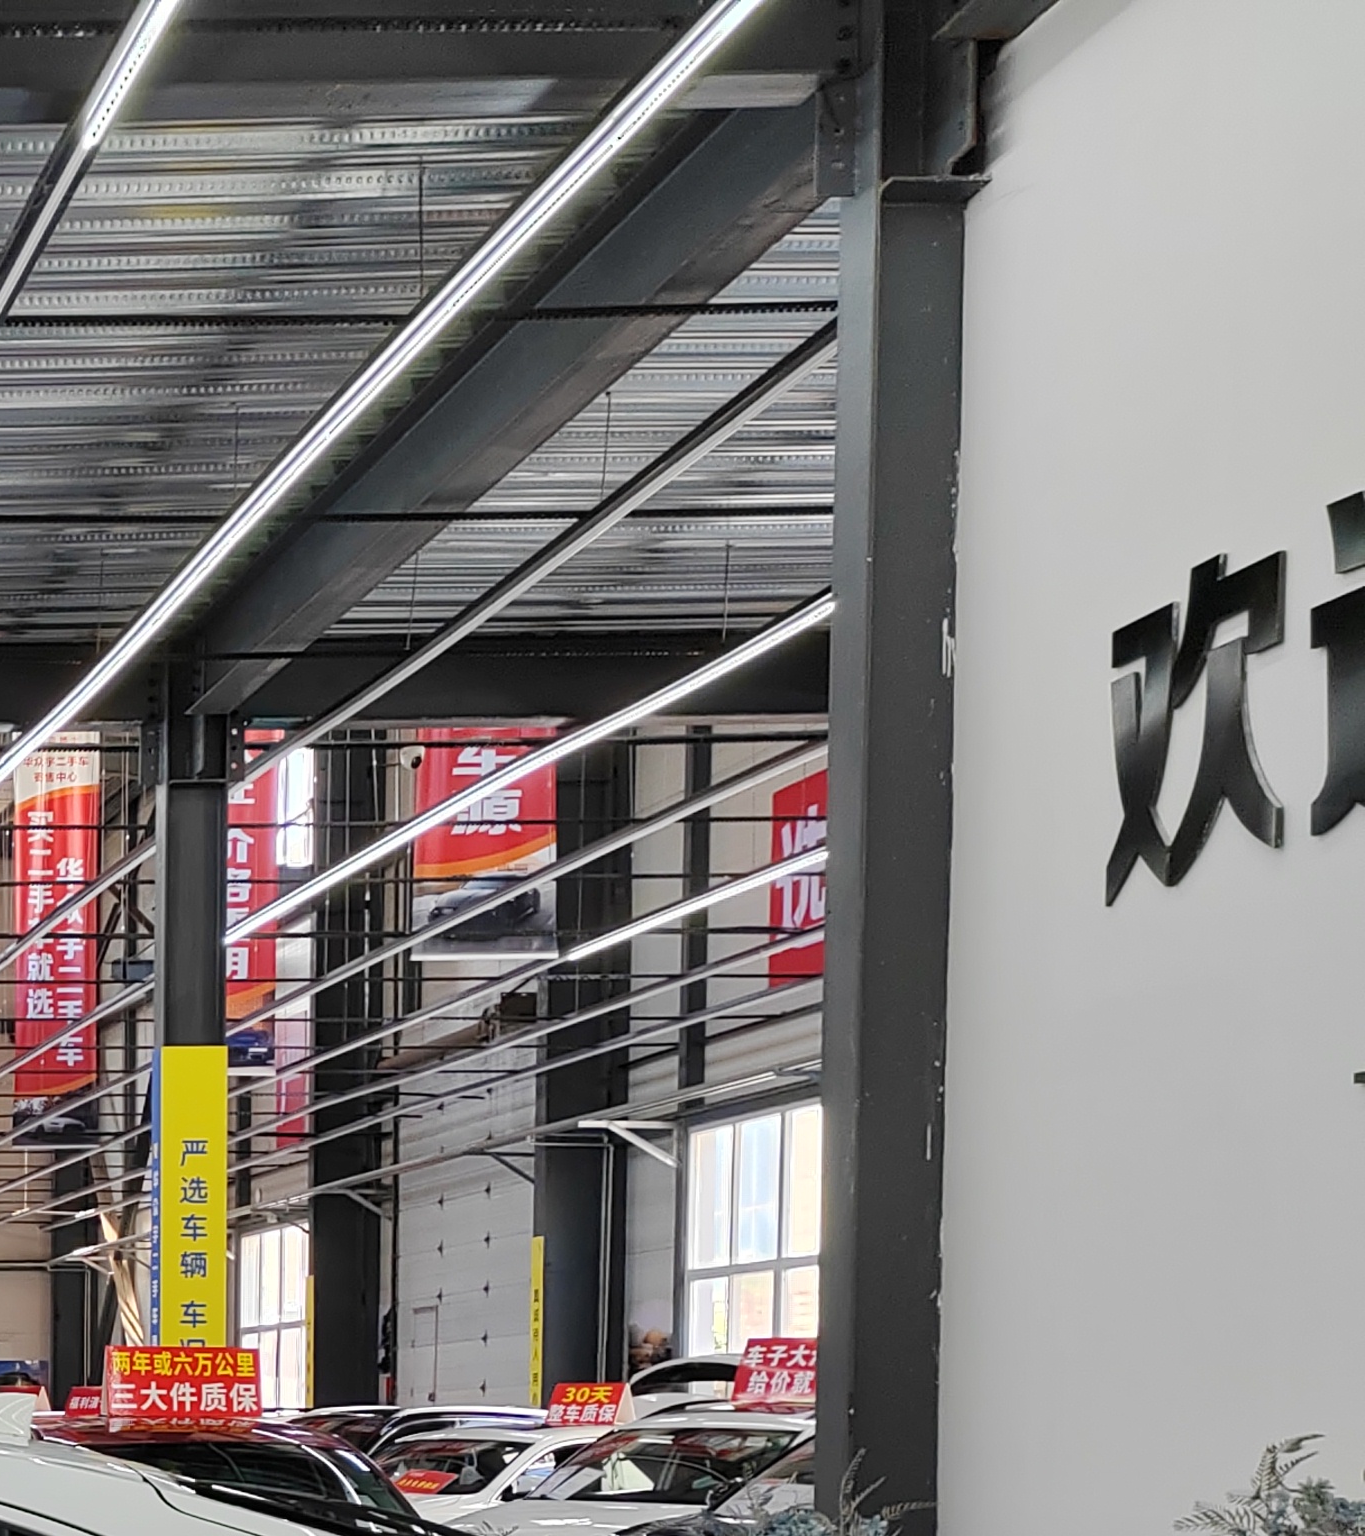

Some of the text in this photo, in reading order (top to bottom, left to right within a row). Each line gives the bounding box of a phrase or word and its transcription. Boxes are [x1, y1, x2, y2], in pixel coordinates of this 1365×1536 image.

[1104, 490, 1365, 907] 欢
[179, 1139, 209, 1279] 严选车辆
[111, 1351, 256, 1378] 两年或六万公里
[110, 1382, 259, 1413] 三大件质保
[562, 1386, 613, 1404] 30天
[546, 1404, 616, 1423] 整车质保
